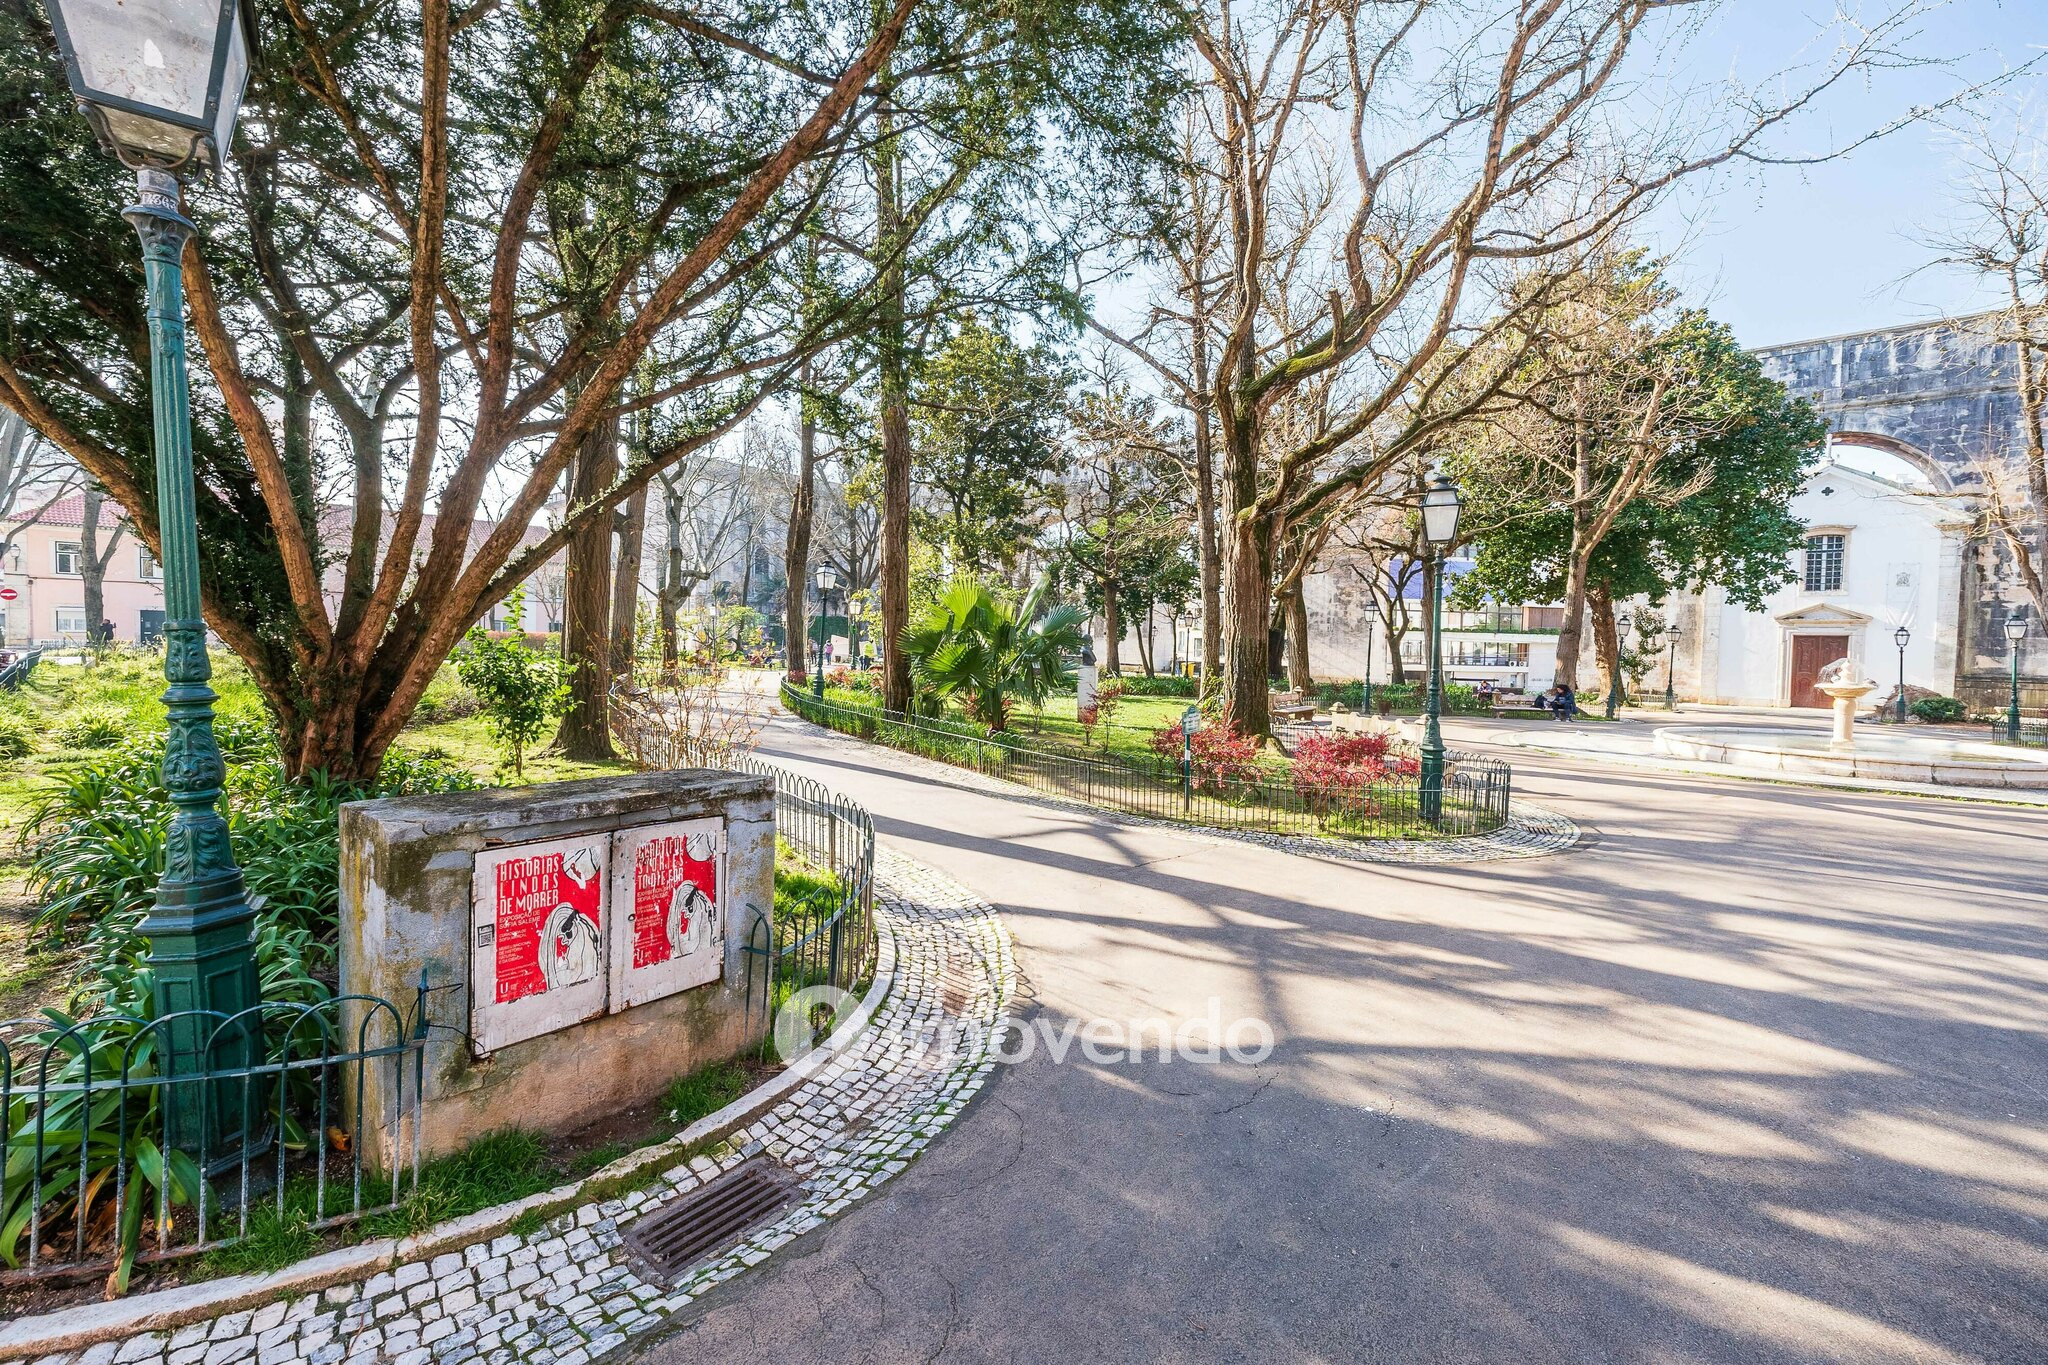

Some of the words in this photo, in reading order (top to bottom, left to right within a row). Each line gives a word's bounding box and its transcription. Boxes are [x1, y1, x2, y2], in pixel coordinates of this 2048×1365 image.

[638, 852, 683, 875] STORIES
[500, 873, 559, 899] LINDAS
[500, 898, 513, 916] DE
[516, 889, 559, 913] MORRER
